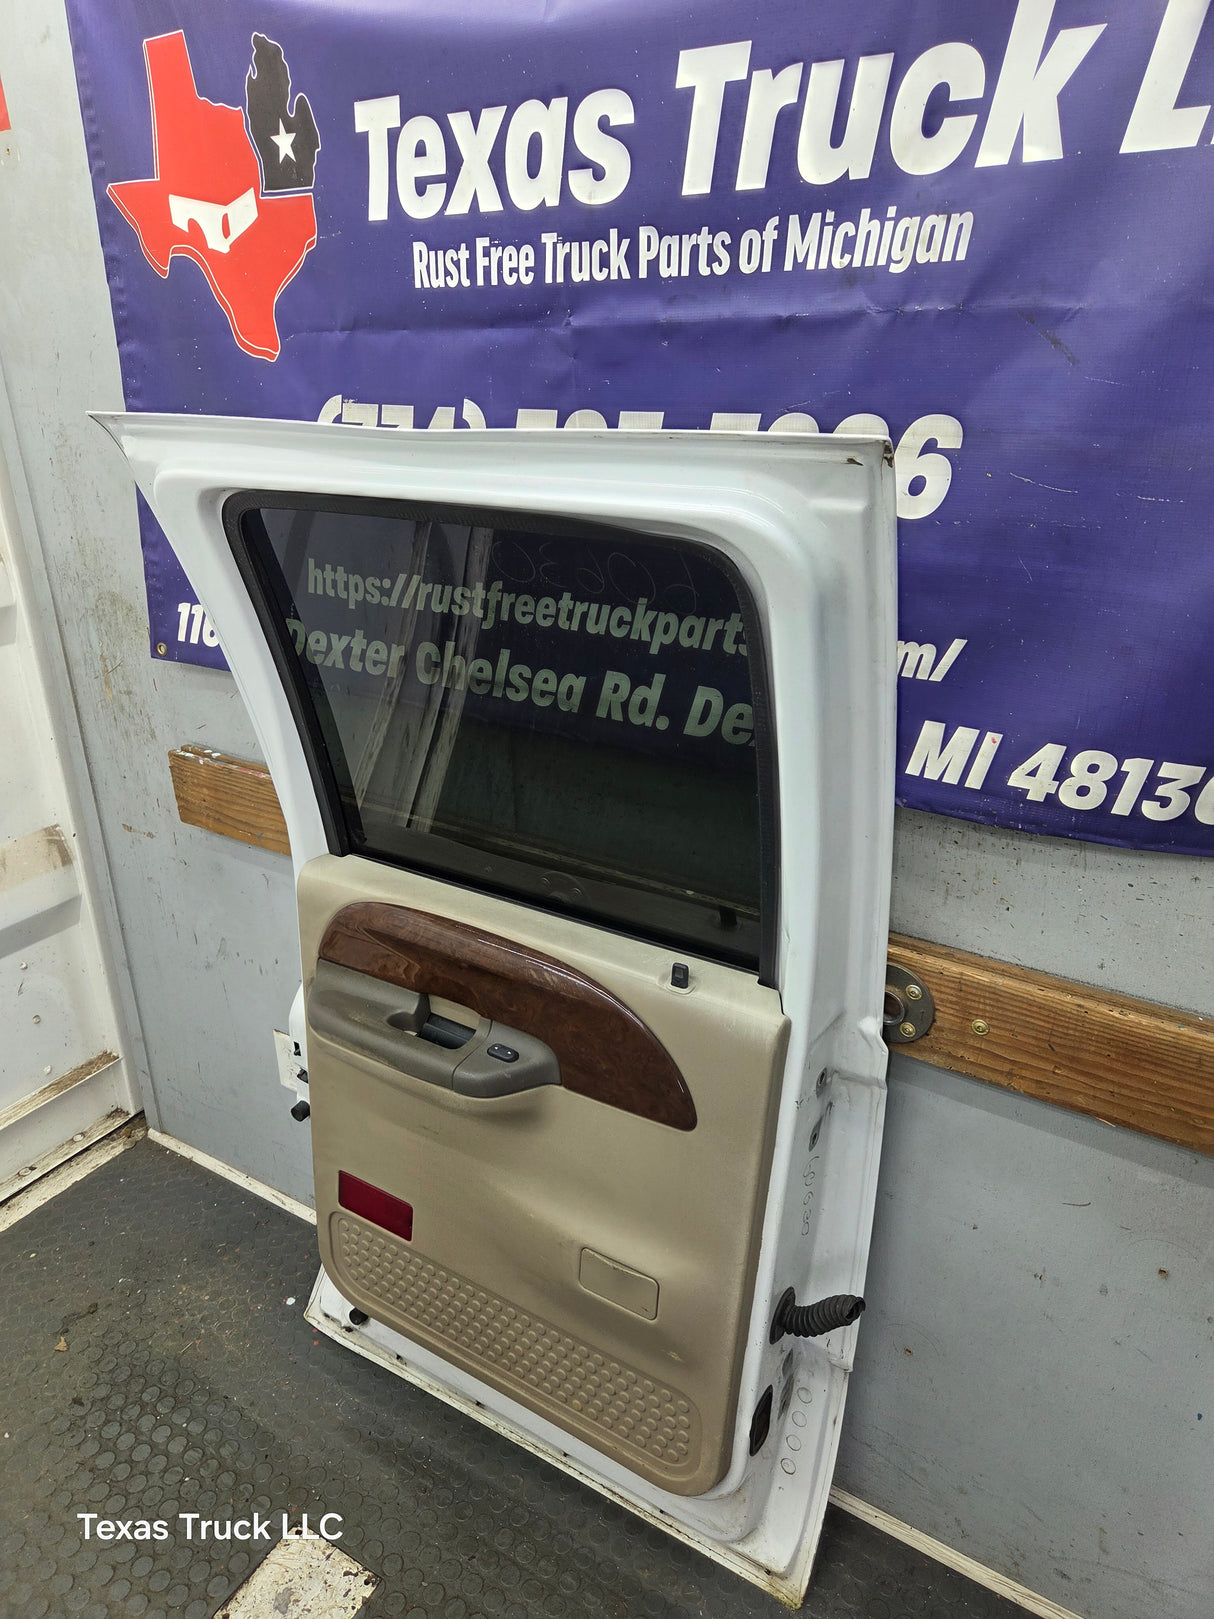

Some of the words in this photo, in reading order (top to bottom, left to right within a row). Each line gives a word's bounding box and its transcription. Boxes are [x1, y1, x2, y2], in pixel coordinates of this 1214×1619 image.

[354, 88, 635, 222] Texas
[675, 0, 1108, 197] Truck
[1118, 0, 1214, 154] L
[412, 240, 472, 290] Rust
[475, 237, 536, 288] Free
[541, 229, 631, 284] Truck
[637, 222, 731, 279] Parts
[738, 215, 781, 274] of
[785, 205, 975, 275] Michigan
[306, 557, 748, 657] https://rustfreetruckpart
[415, 641, 586, 715] Chelsea
[594, 671, 670, 732] Rd.
[682, 685, 756, 746] De
[905, 720, 1004, 790] MI
